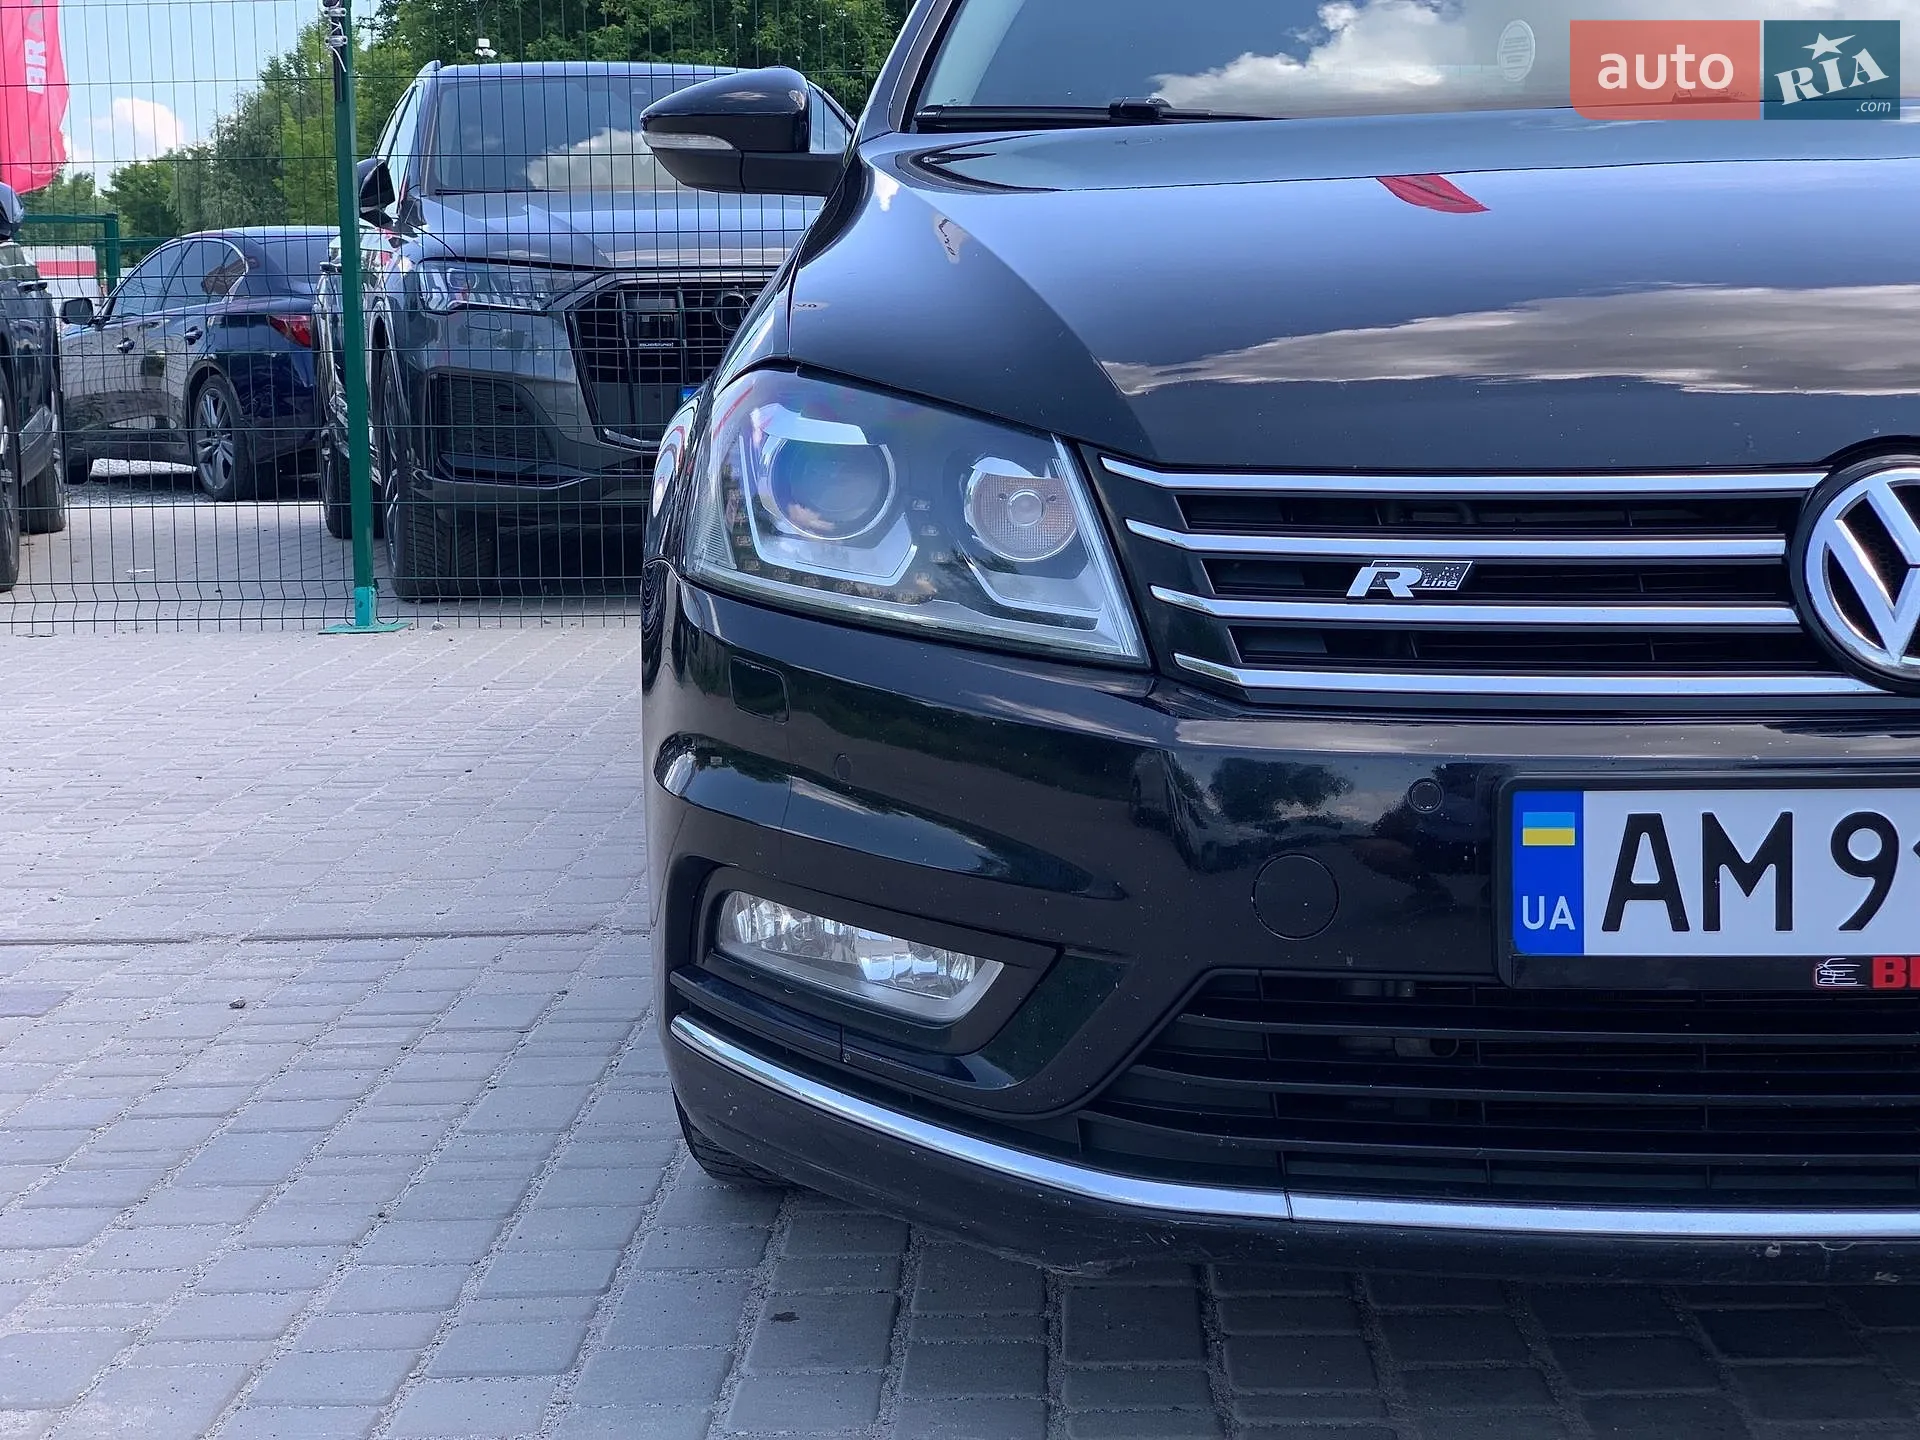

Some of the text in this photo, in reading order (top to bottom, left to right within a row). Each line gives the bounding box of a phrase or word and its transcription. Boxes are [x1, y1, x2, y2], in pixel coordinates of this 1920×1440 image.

[1346, 566, 1458, 598] R Line
[1601, 811, 1920, 932] AM 9
[1521, 895, 1576, 931] UA
